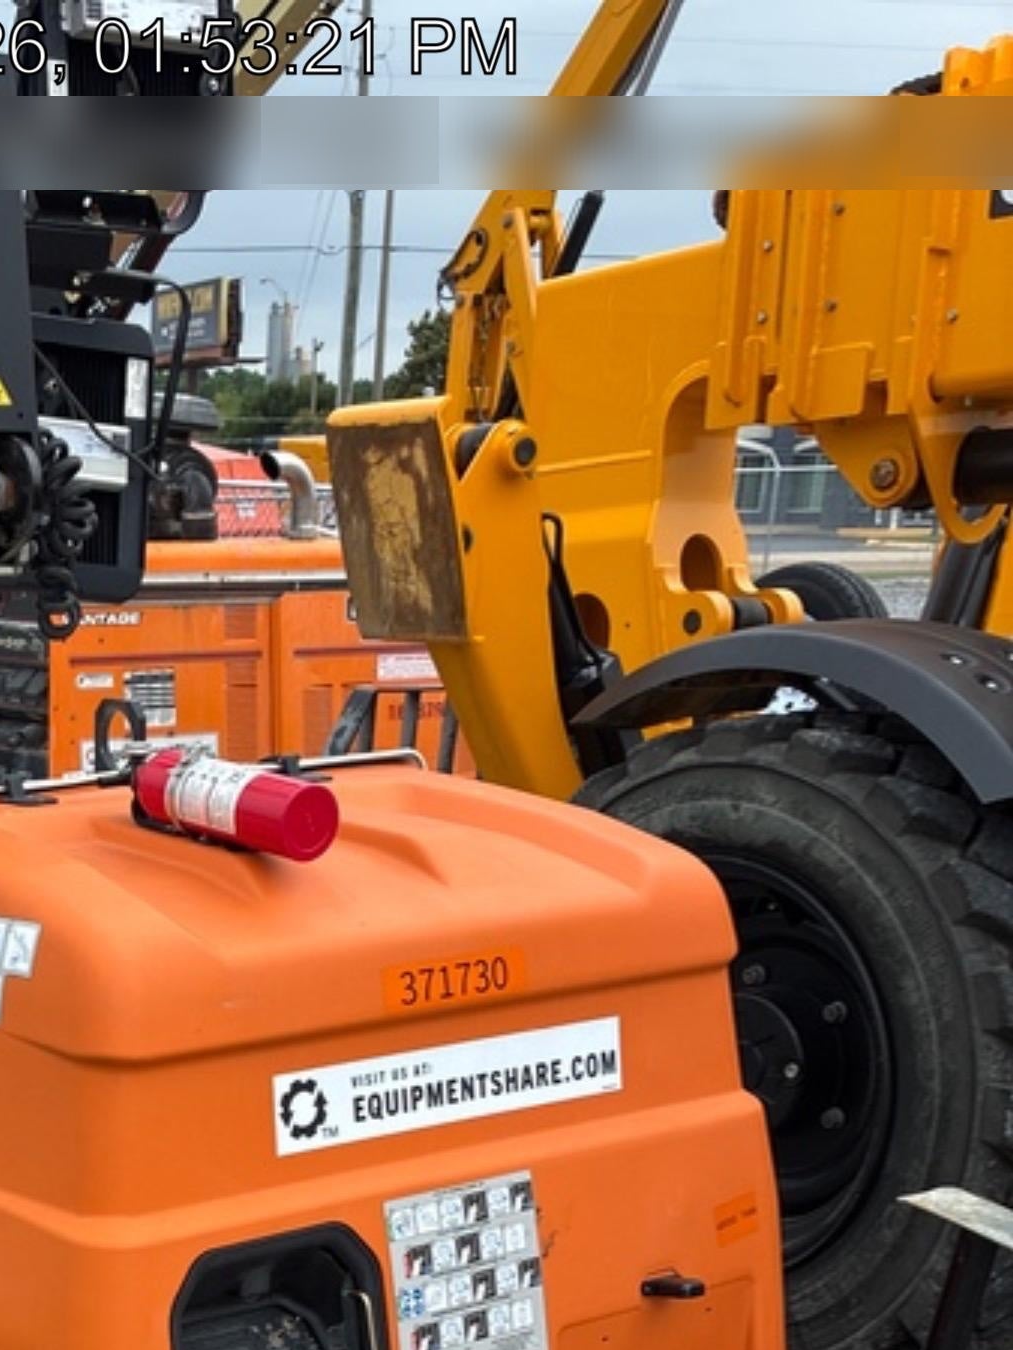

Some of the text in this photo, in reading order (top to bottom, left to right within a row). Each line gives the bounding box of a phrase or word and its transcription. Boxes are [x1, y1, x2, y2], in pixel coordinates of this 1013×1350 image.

[399, 957, 508, 1006] 371730
[350, 1070, 385, 1088] VISIT
[391, 1067, 407, 1081] US
[352, 1050, 617, 1123] EQUIPMENTSHARE.COM
